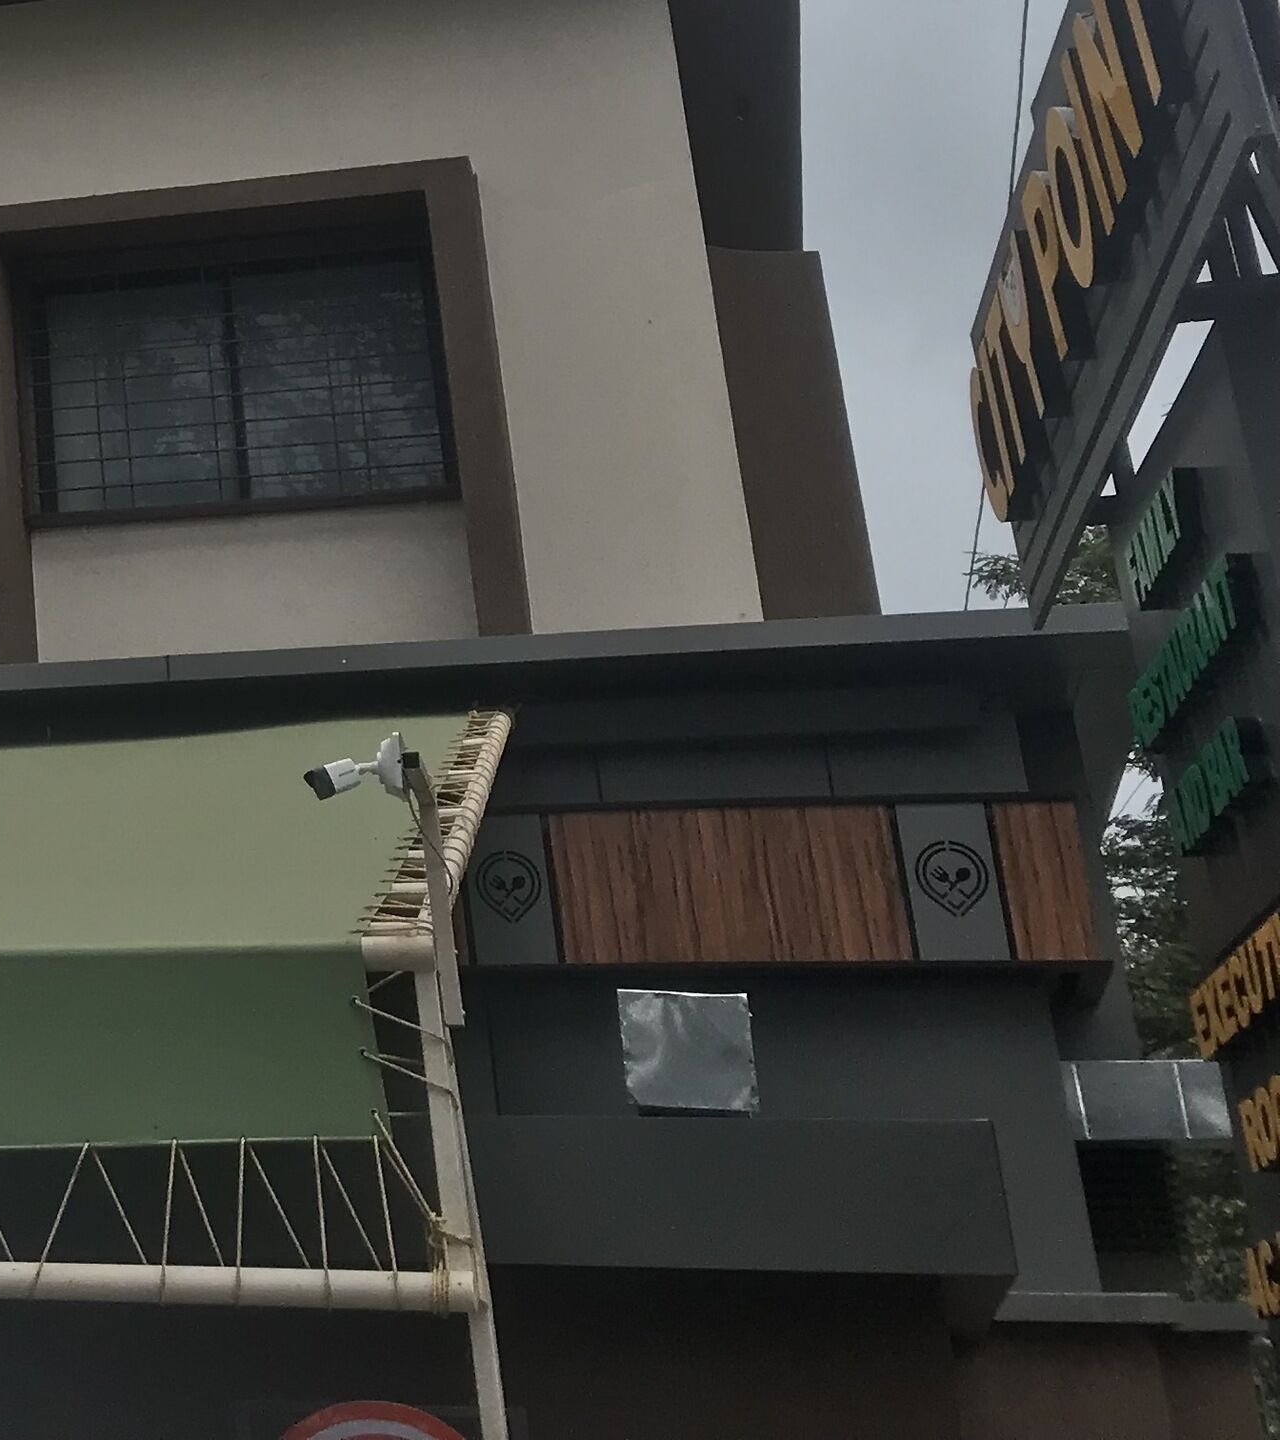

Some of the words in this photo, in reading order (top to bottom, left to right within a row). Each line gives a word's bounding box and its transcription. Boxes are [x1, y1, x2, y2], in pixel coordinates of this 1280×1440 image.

[970, 228, 1045, 522] CITY
[1127, 466, 1181, 607] FAMILY
[1127, 553, 1237, 747] RESTAURANT
[1172, 763, 1211, 856] AND
[1200, 715, 1250, 817] BAR
